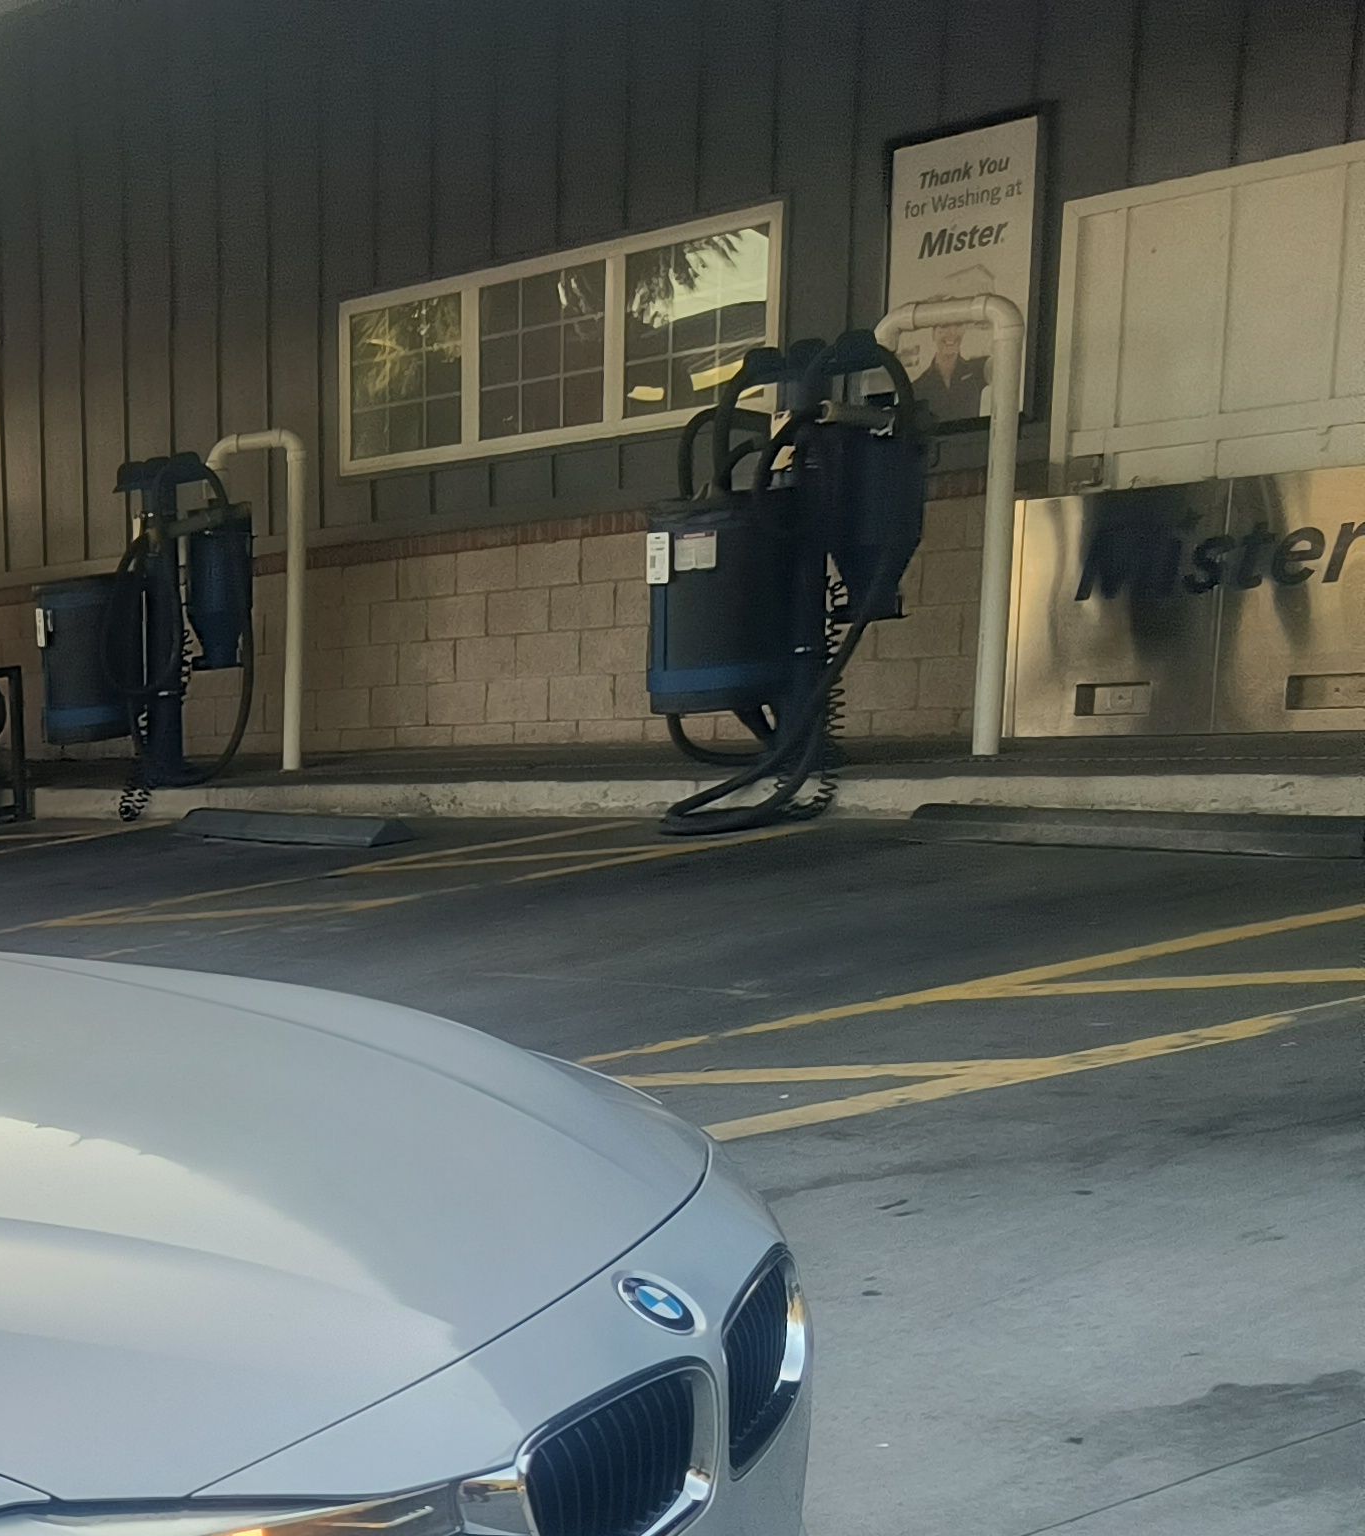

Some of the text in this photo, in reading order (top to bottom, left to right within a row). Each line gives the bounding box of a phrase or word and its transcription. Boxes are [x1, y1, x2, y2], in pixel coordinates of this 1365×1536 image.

[919, 156, 1011, 190] Thank You
[904, 178, 1023, 219] for Washing at
[917, 220, 1009, 260] Mister
